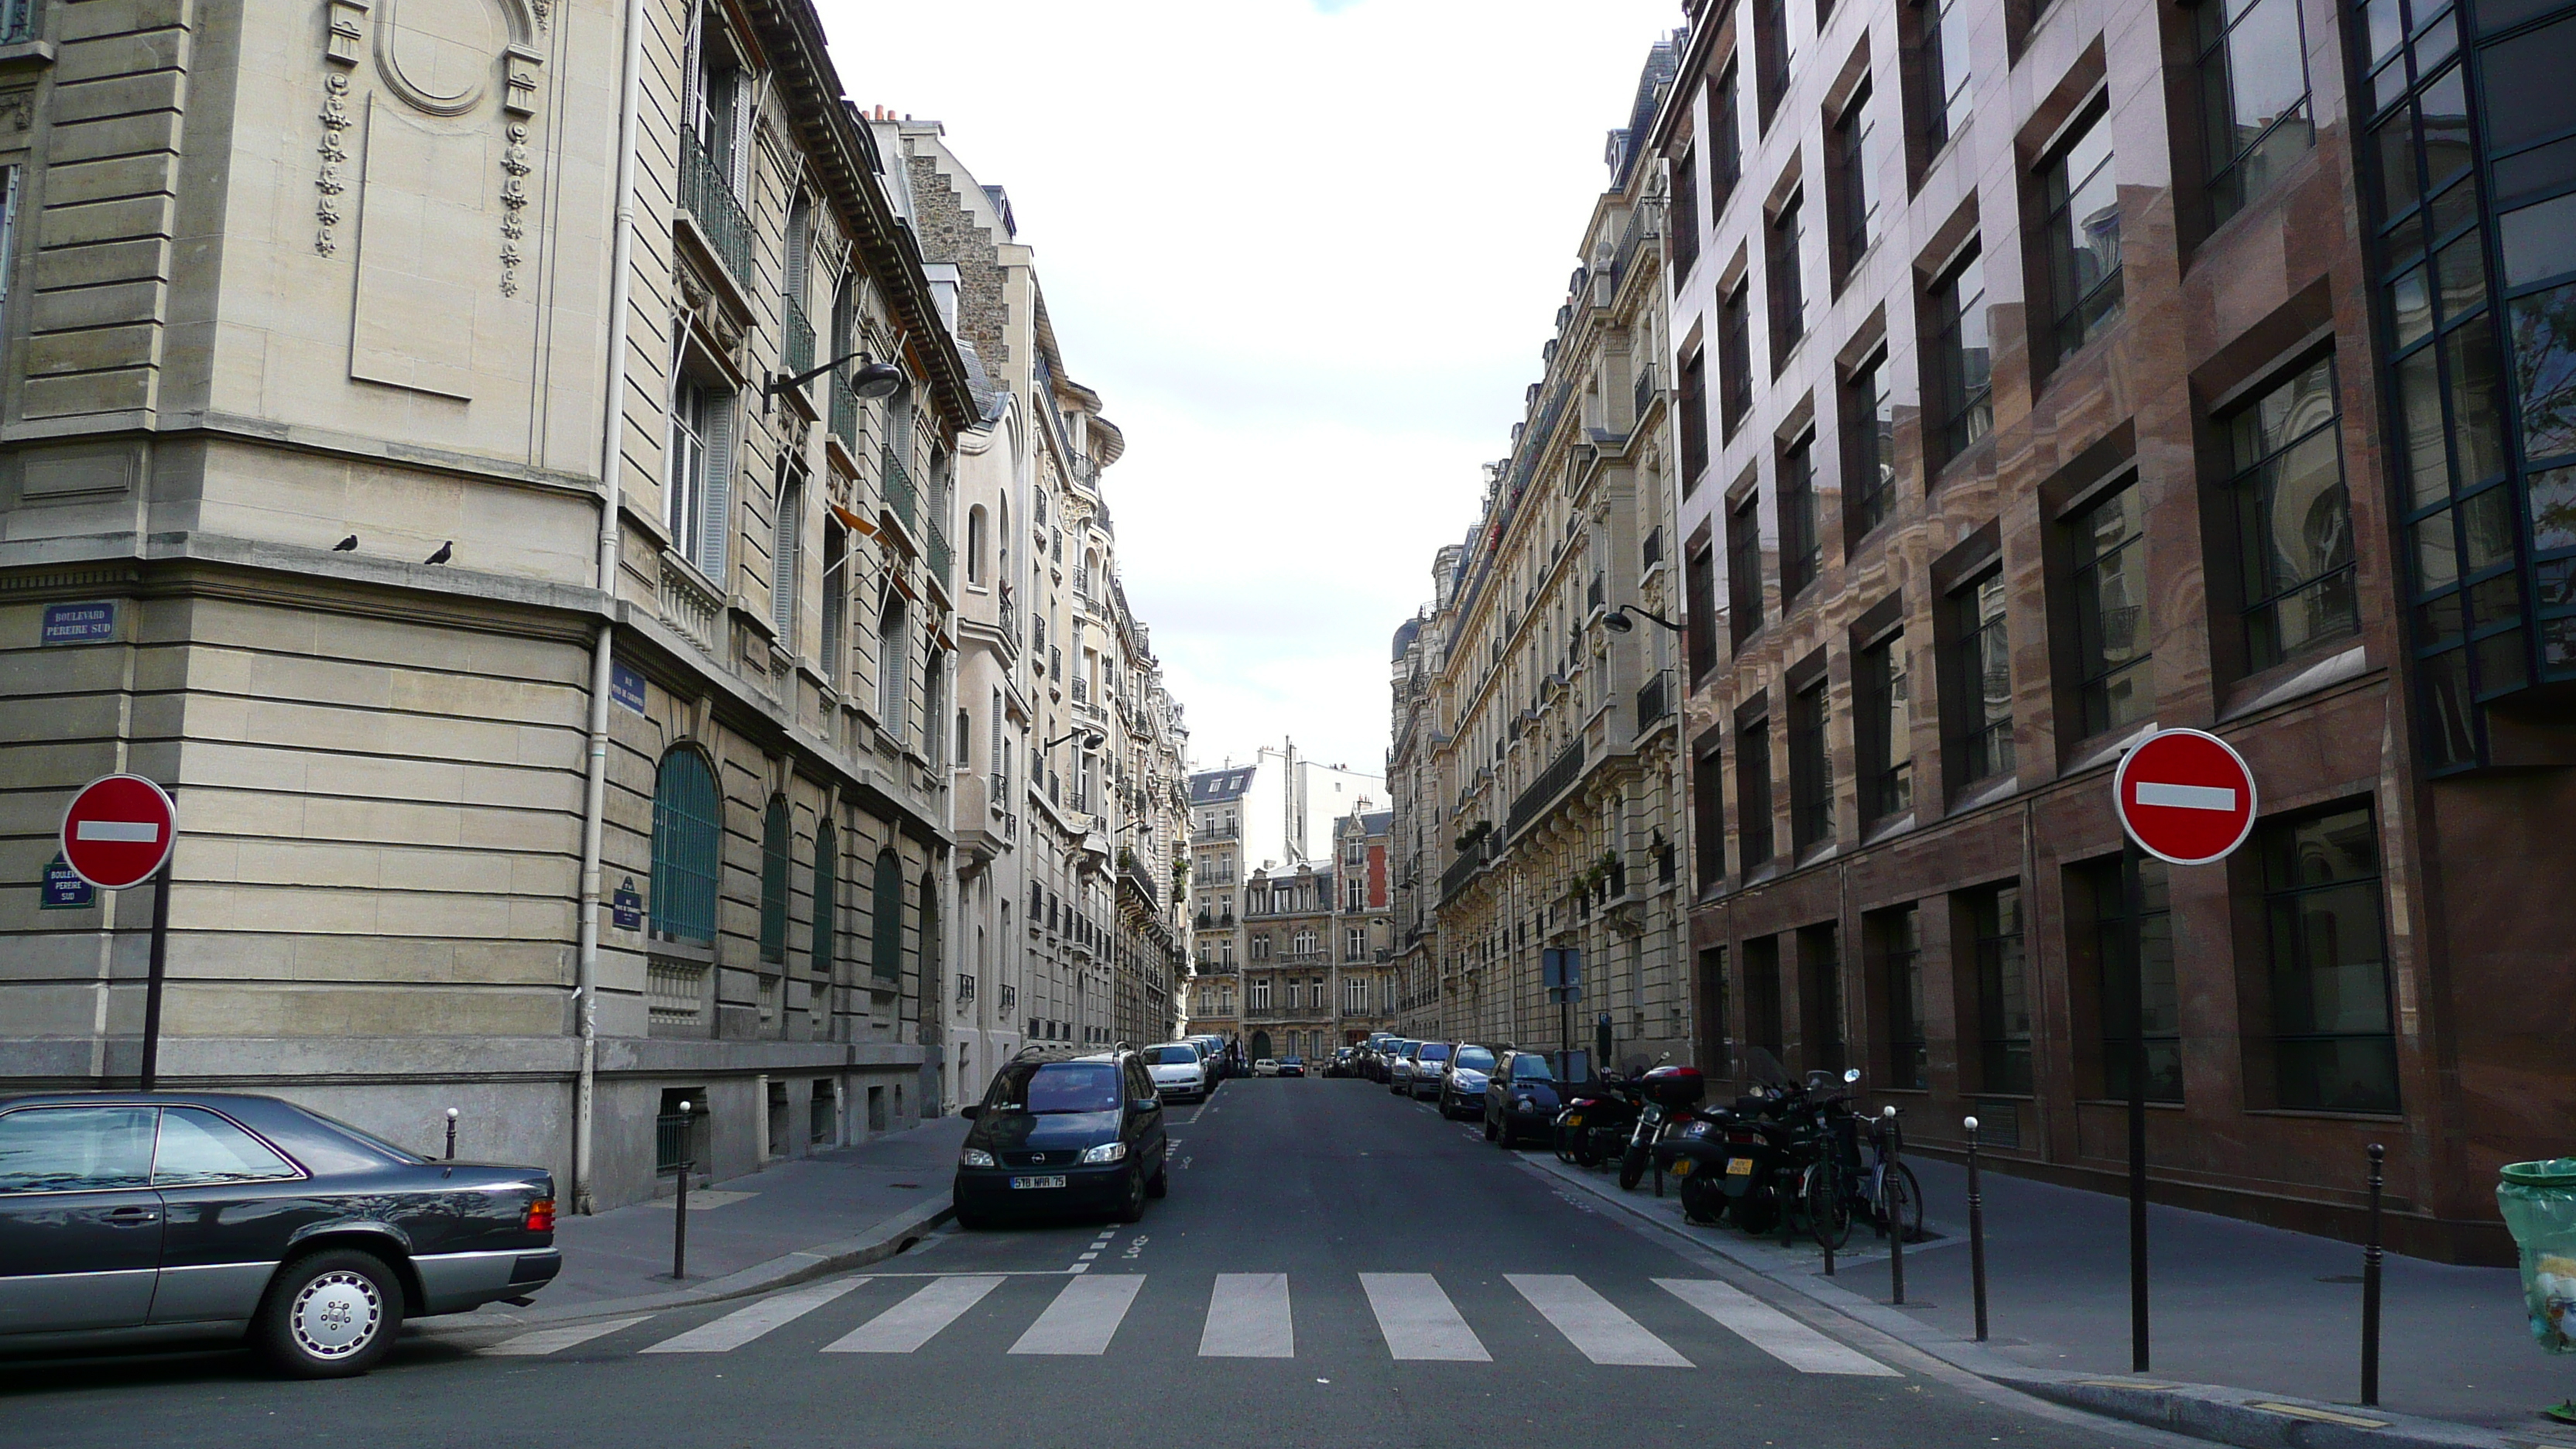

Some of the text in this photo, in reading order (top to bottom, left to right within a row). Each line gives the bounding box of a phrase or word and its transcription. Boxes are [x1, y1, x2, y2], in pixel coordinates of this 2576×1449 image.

[55, 610, 105, 622] BOULEVARD
[91, 623, 111, 633] SUD
[50, 870, 78, 879] BOULEV
[55, 881, 82, 890] PEREIRE
[1053, 1177, 1064, 1186] 75
